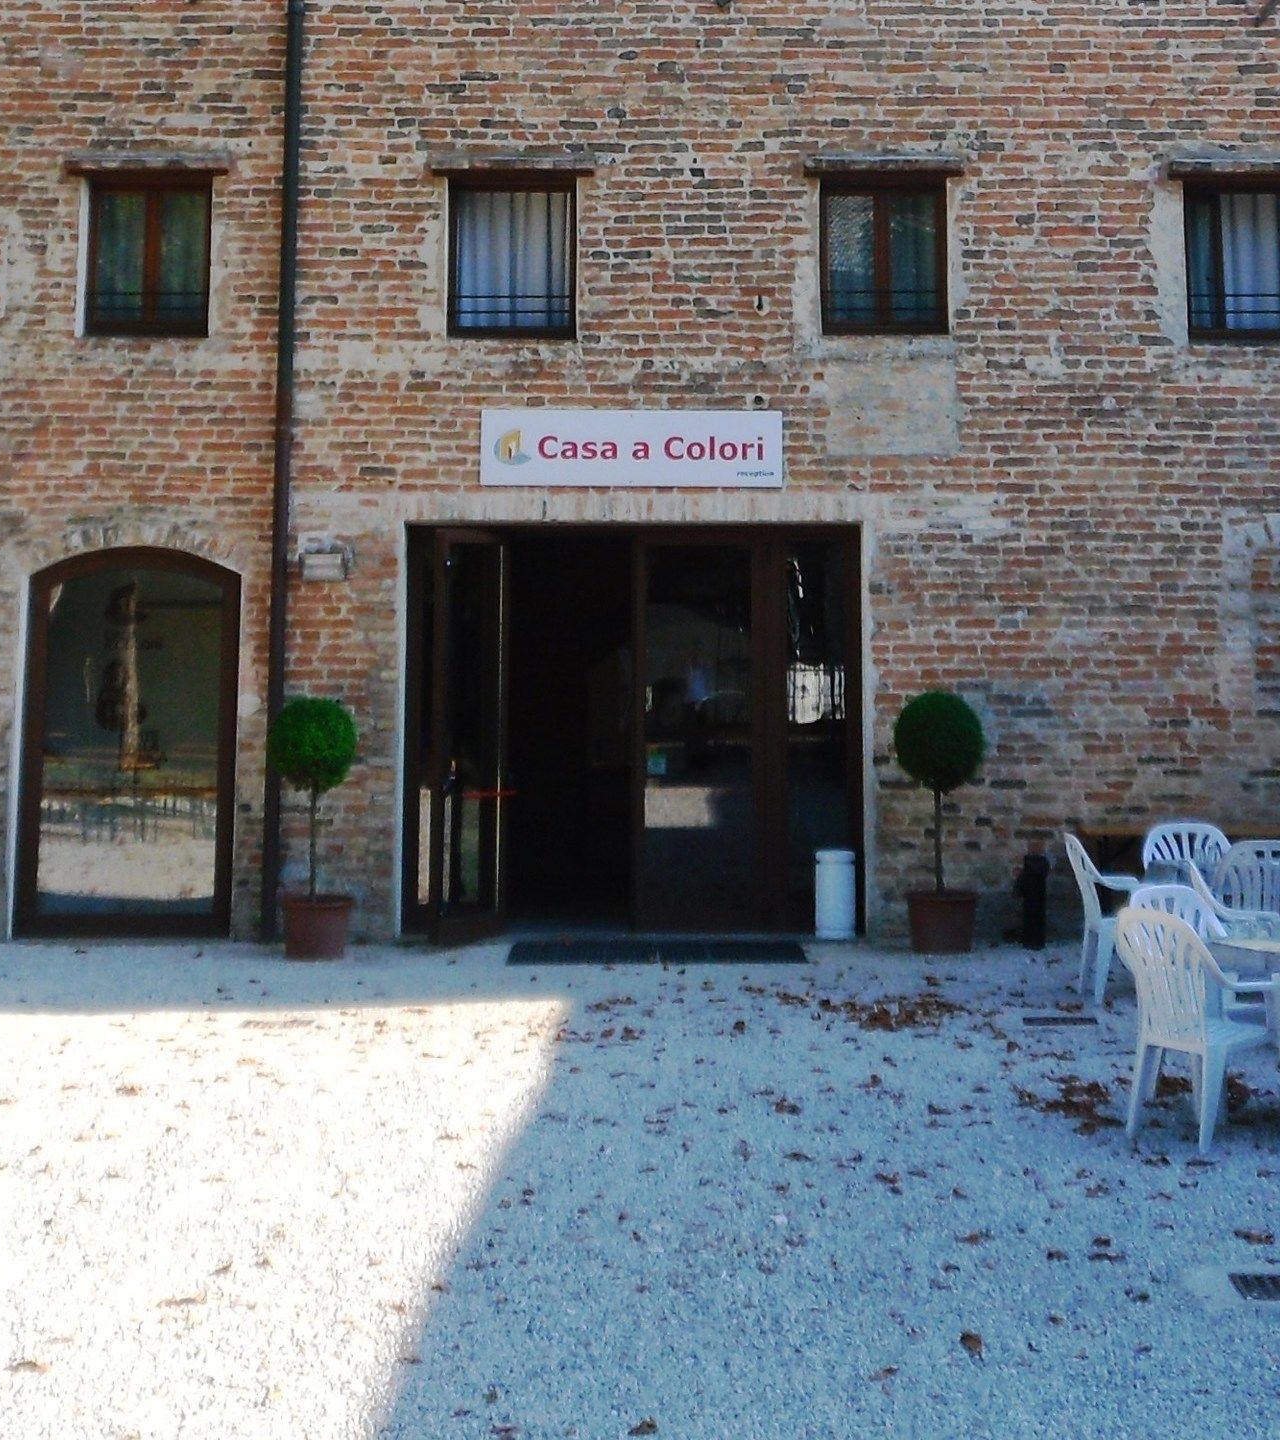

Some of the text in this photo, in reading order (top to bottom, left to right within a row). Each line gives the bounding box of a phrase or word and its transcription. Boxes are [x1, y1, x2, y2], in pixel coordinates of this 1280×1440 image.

[537, 435, 764, 461] Casa a Colori
